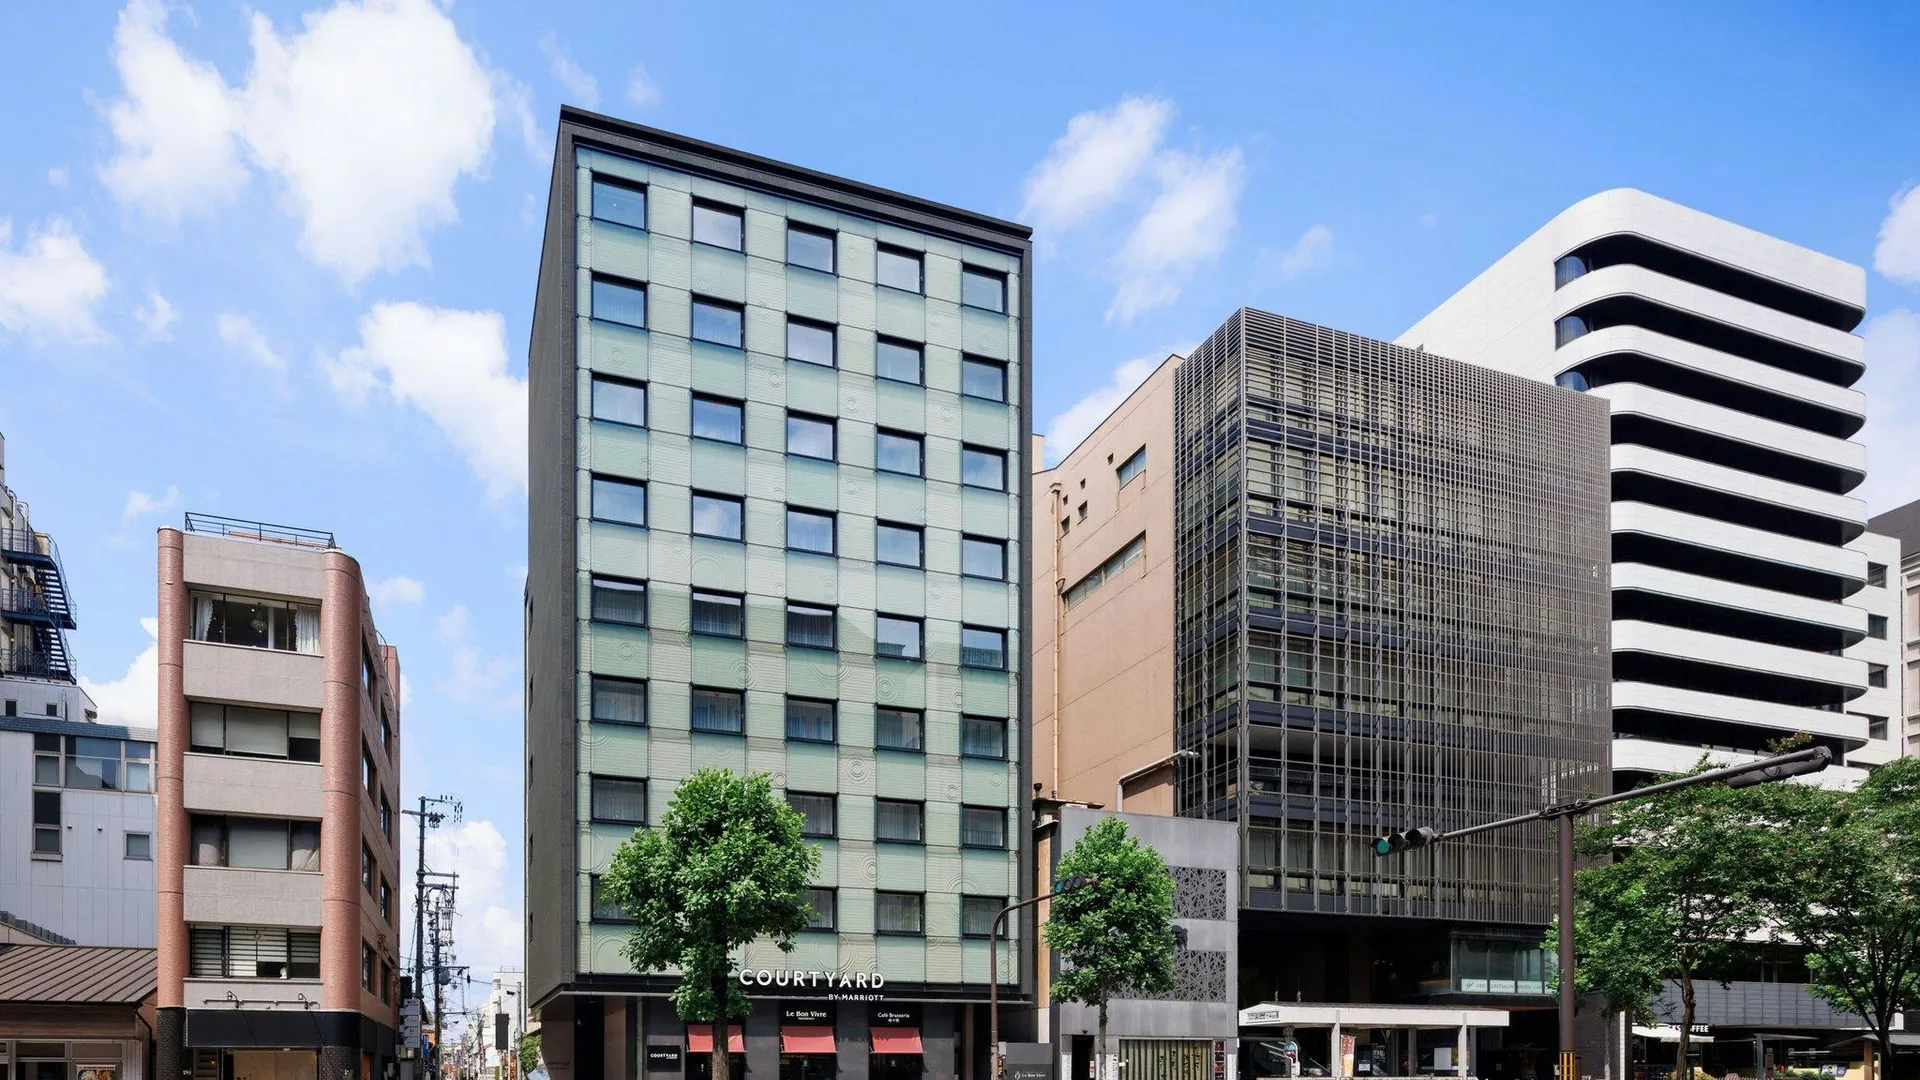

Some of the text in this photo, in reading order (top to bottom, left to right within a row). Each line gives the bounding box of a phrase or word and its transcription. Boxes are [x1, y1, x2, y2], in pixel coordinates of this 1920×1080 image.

[739, 969, 884, 989] COURTYARD
[842, 994, 885, 1002] MARRIOTT
[796, 1010, 809, 1018] Bon
[810, 1010, 827, 1018] Vivre
[1689, 1024, 1709, 1032] FFEE
